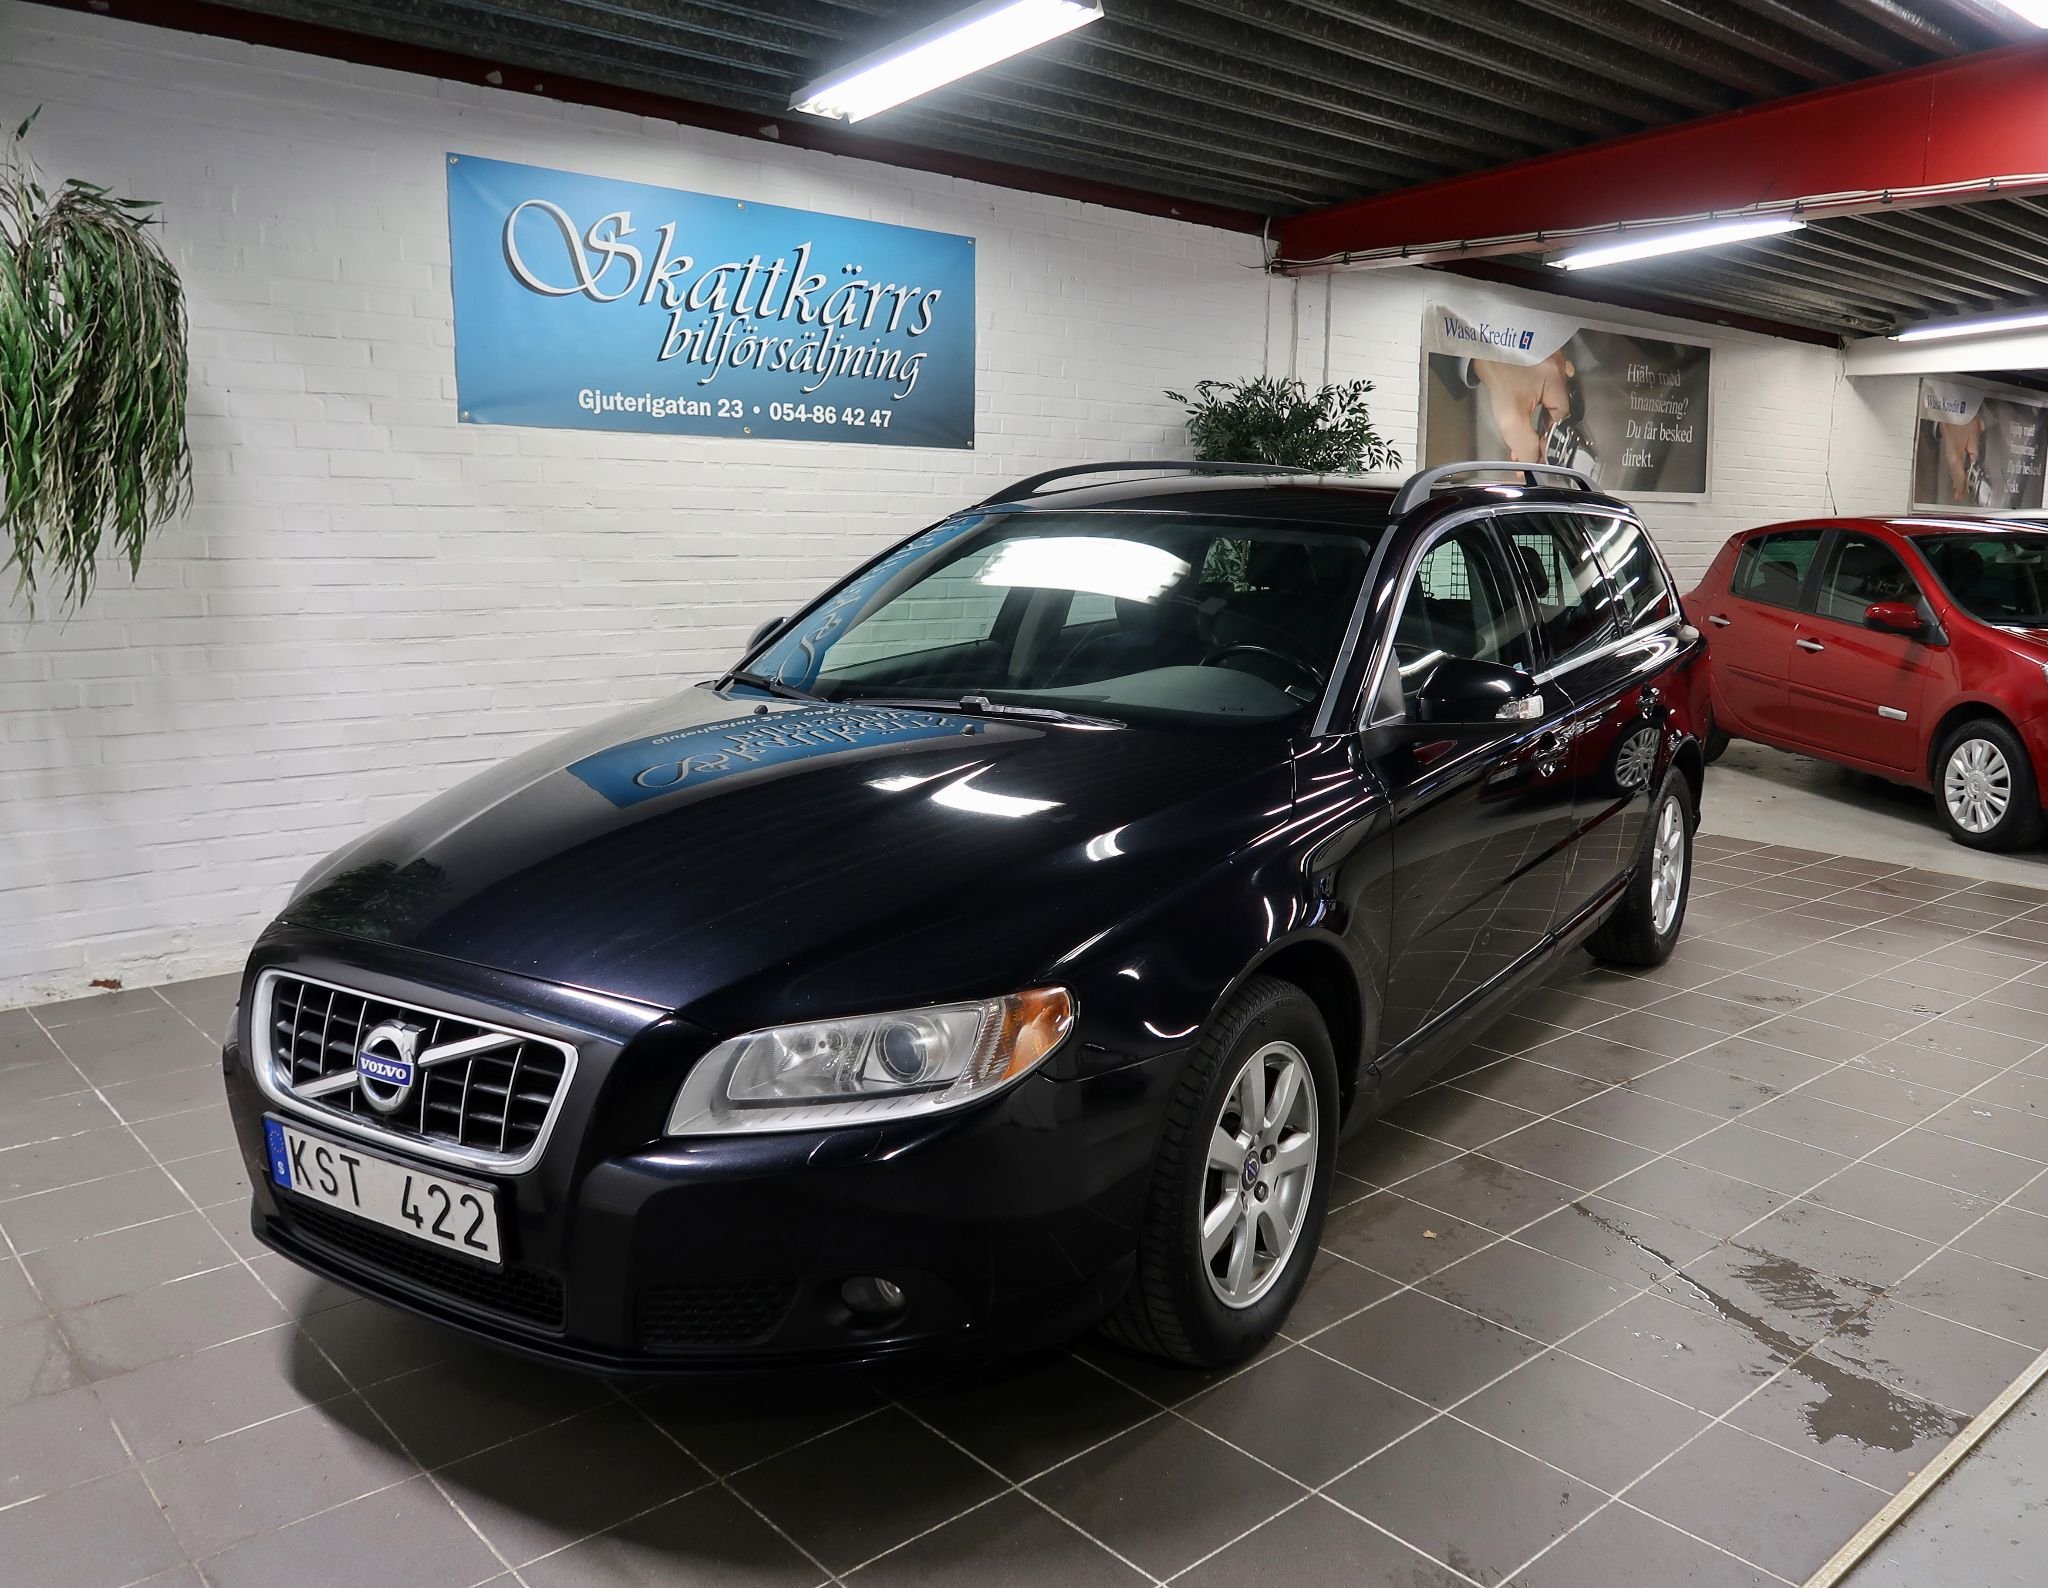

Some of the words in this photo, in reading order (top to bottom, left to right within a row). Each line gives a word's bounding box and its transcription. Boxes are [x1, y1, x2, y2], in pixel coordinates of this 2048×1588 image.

[504, 199, 942, 337] Skattkärrs
[1443, 316, 1477, 342] Wasa
[1480, 323, 1518, 348] Kredit
[657, 308, 928, 401] bilförsäljning
[1627, 363, 1656, 389] Hjälp
[1658, 369, 1681, 387] med
[578, 388, 712, 418] Gjuterigatan
[717, 398, 744, 419] 23
[769, 402, 837, 425] 054-86
[842, 408, 865, 427] 42
[870, 409, 892, 428] 47
[1629, 390, 1689, 420] finansiering?
[1625, 419, 1641, 440] Du
[1643, 420, 1658, 441] får
[1659, 422, 1693, 443] besked
[1621, 447, 1654, 468] direkt.
[360, 1056, 408, 1081] VOLVO
[276, 1160, 286, 1176] S
[287, 1134, 361, 1208] KST
[401, 1175, 489, 1252] 422
